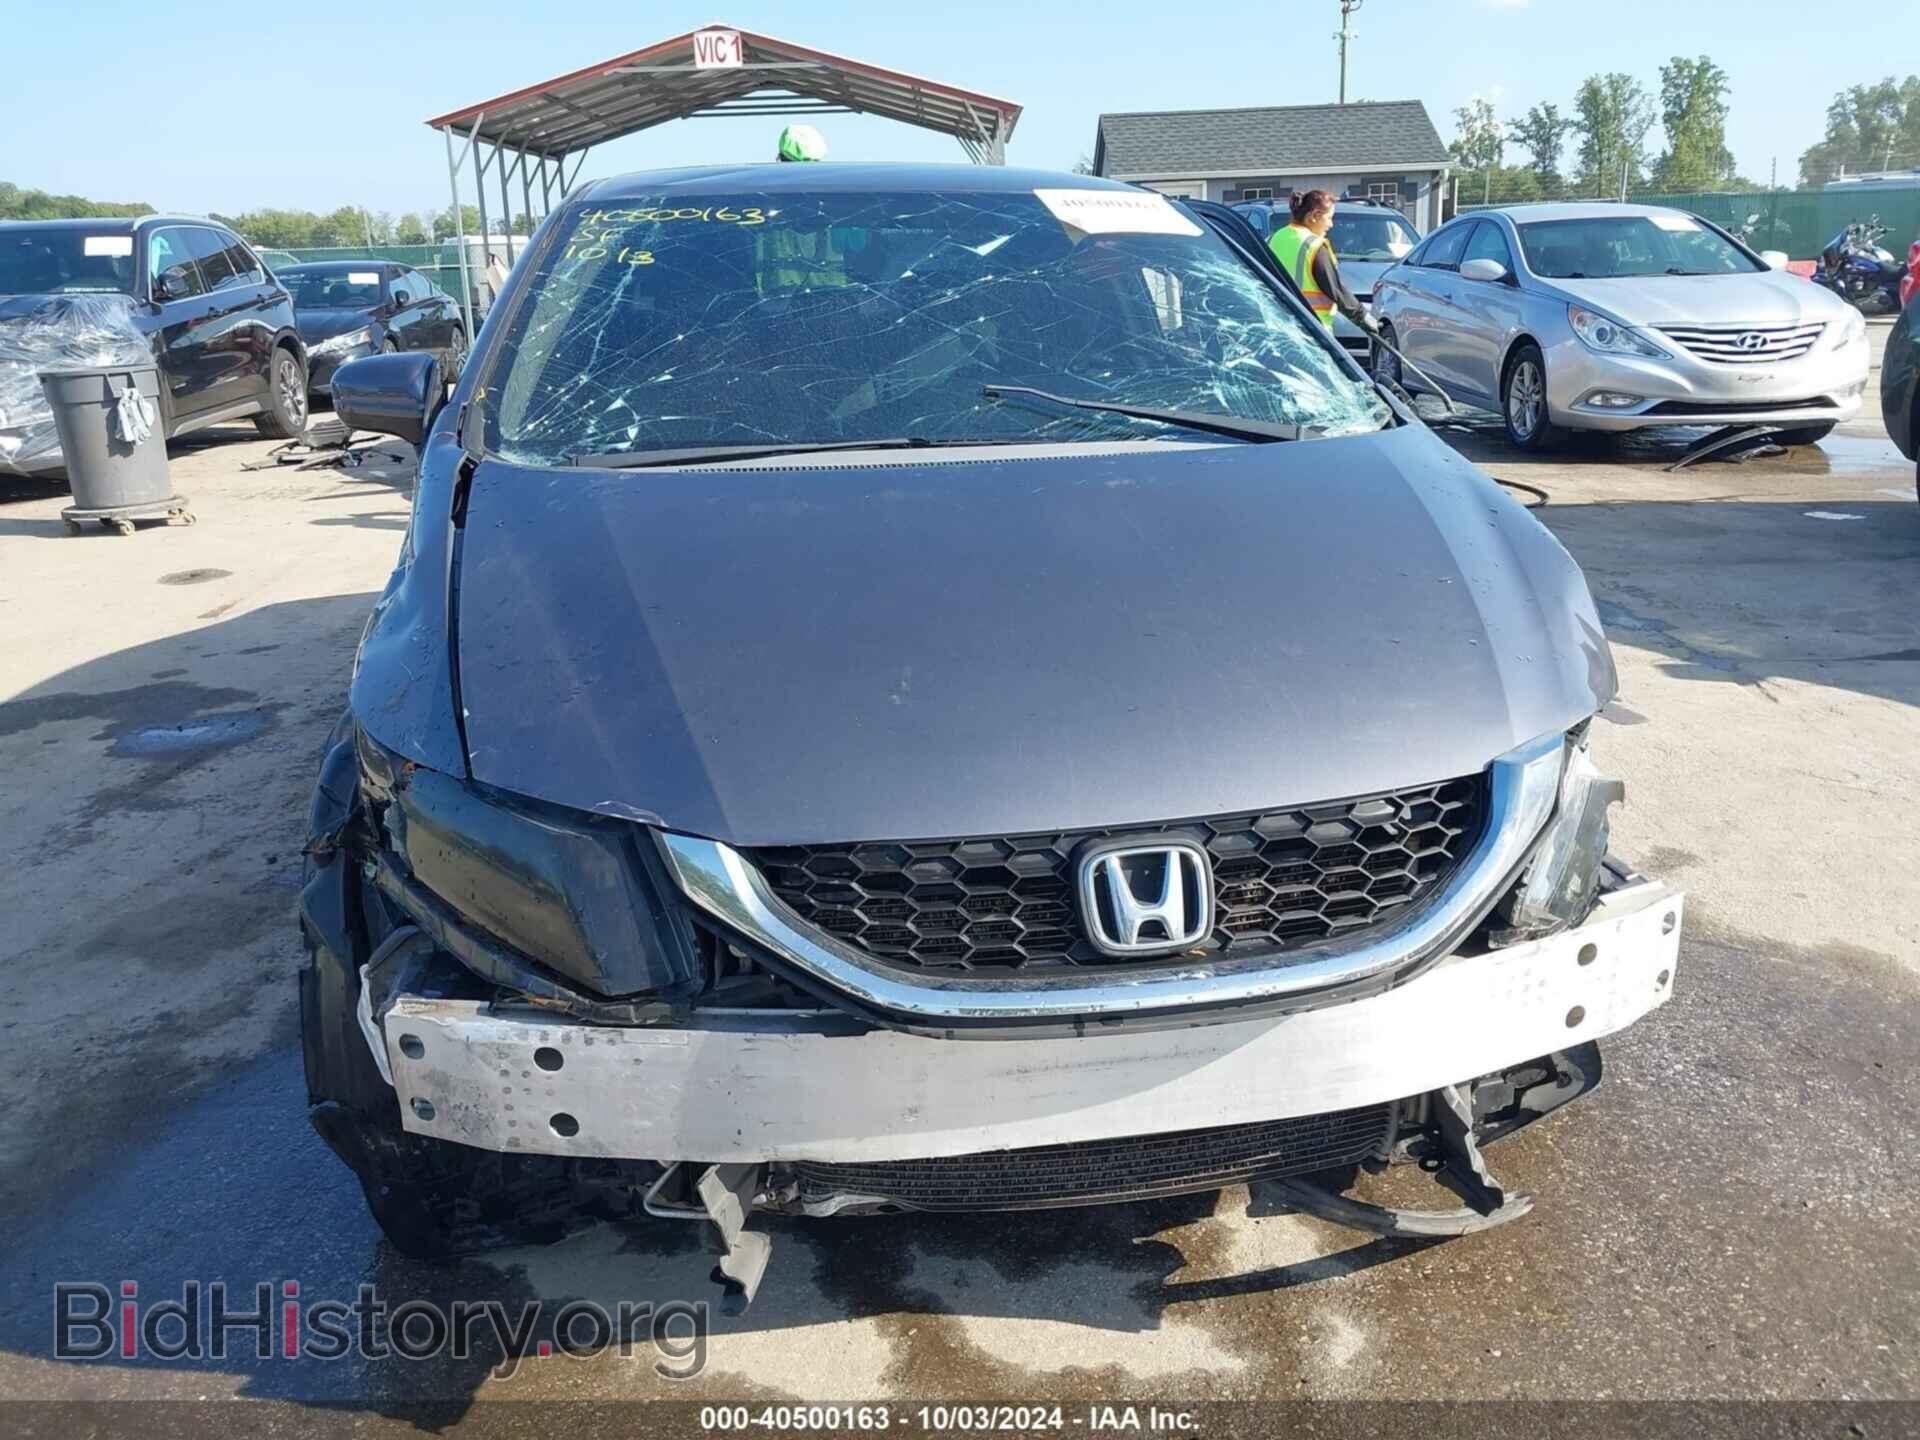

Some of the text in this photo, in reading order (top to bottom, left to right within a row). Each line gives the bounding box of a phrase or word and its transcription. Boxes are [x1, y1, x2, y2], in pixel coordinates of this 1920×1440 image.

[695, 35, 741, 63] VIC 1
[579, 207, 766, 225] 40500163
